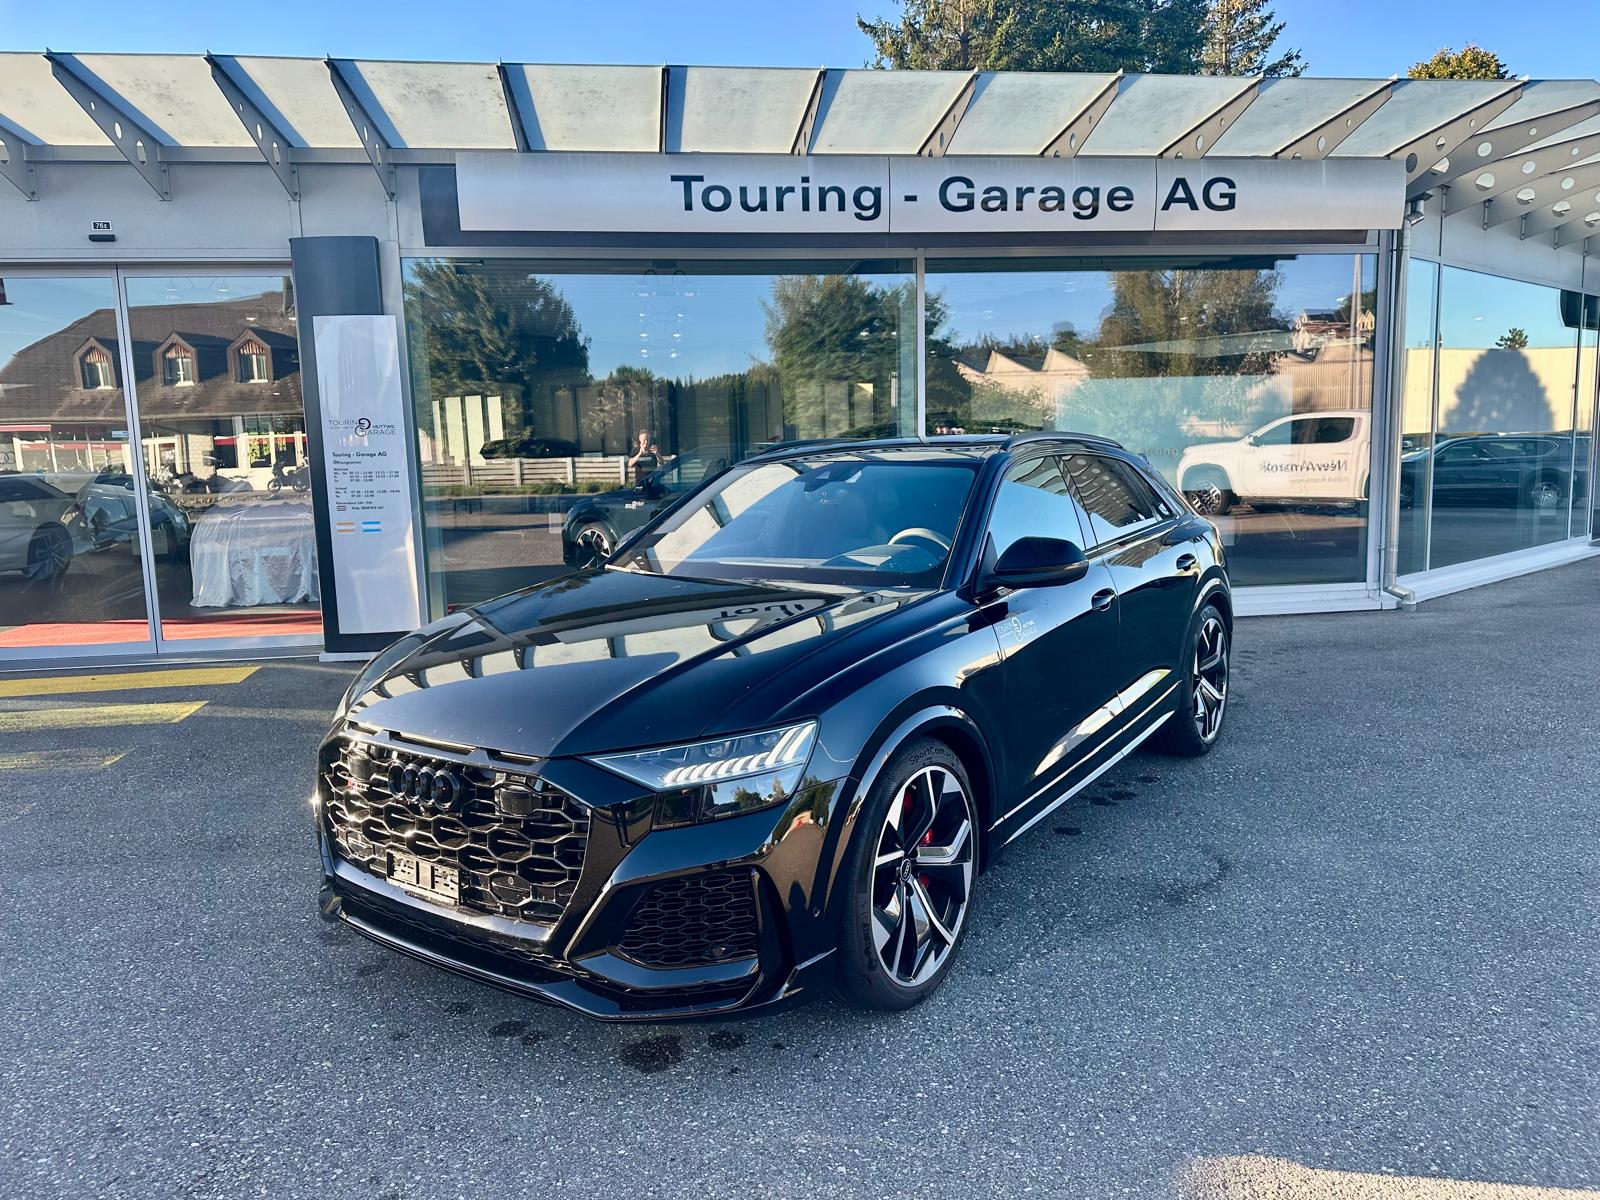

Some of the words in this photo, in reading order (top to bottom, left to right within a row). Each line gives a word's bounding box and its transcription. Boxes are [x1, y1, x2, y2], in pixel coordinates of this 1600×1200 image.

[670, 174, 883, 221] Touring
[938, 176, 1135, 220] Garage
[1161, 177, 1237, 213] AG
